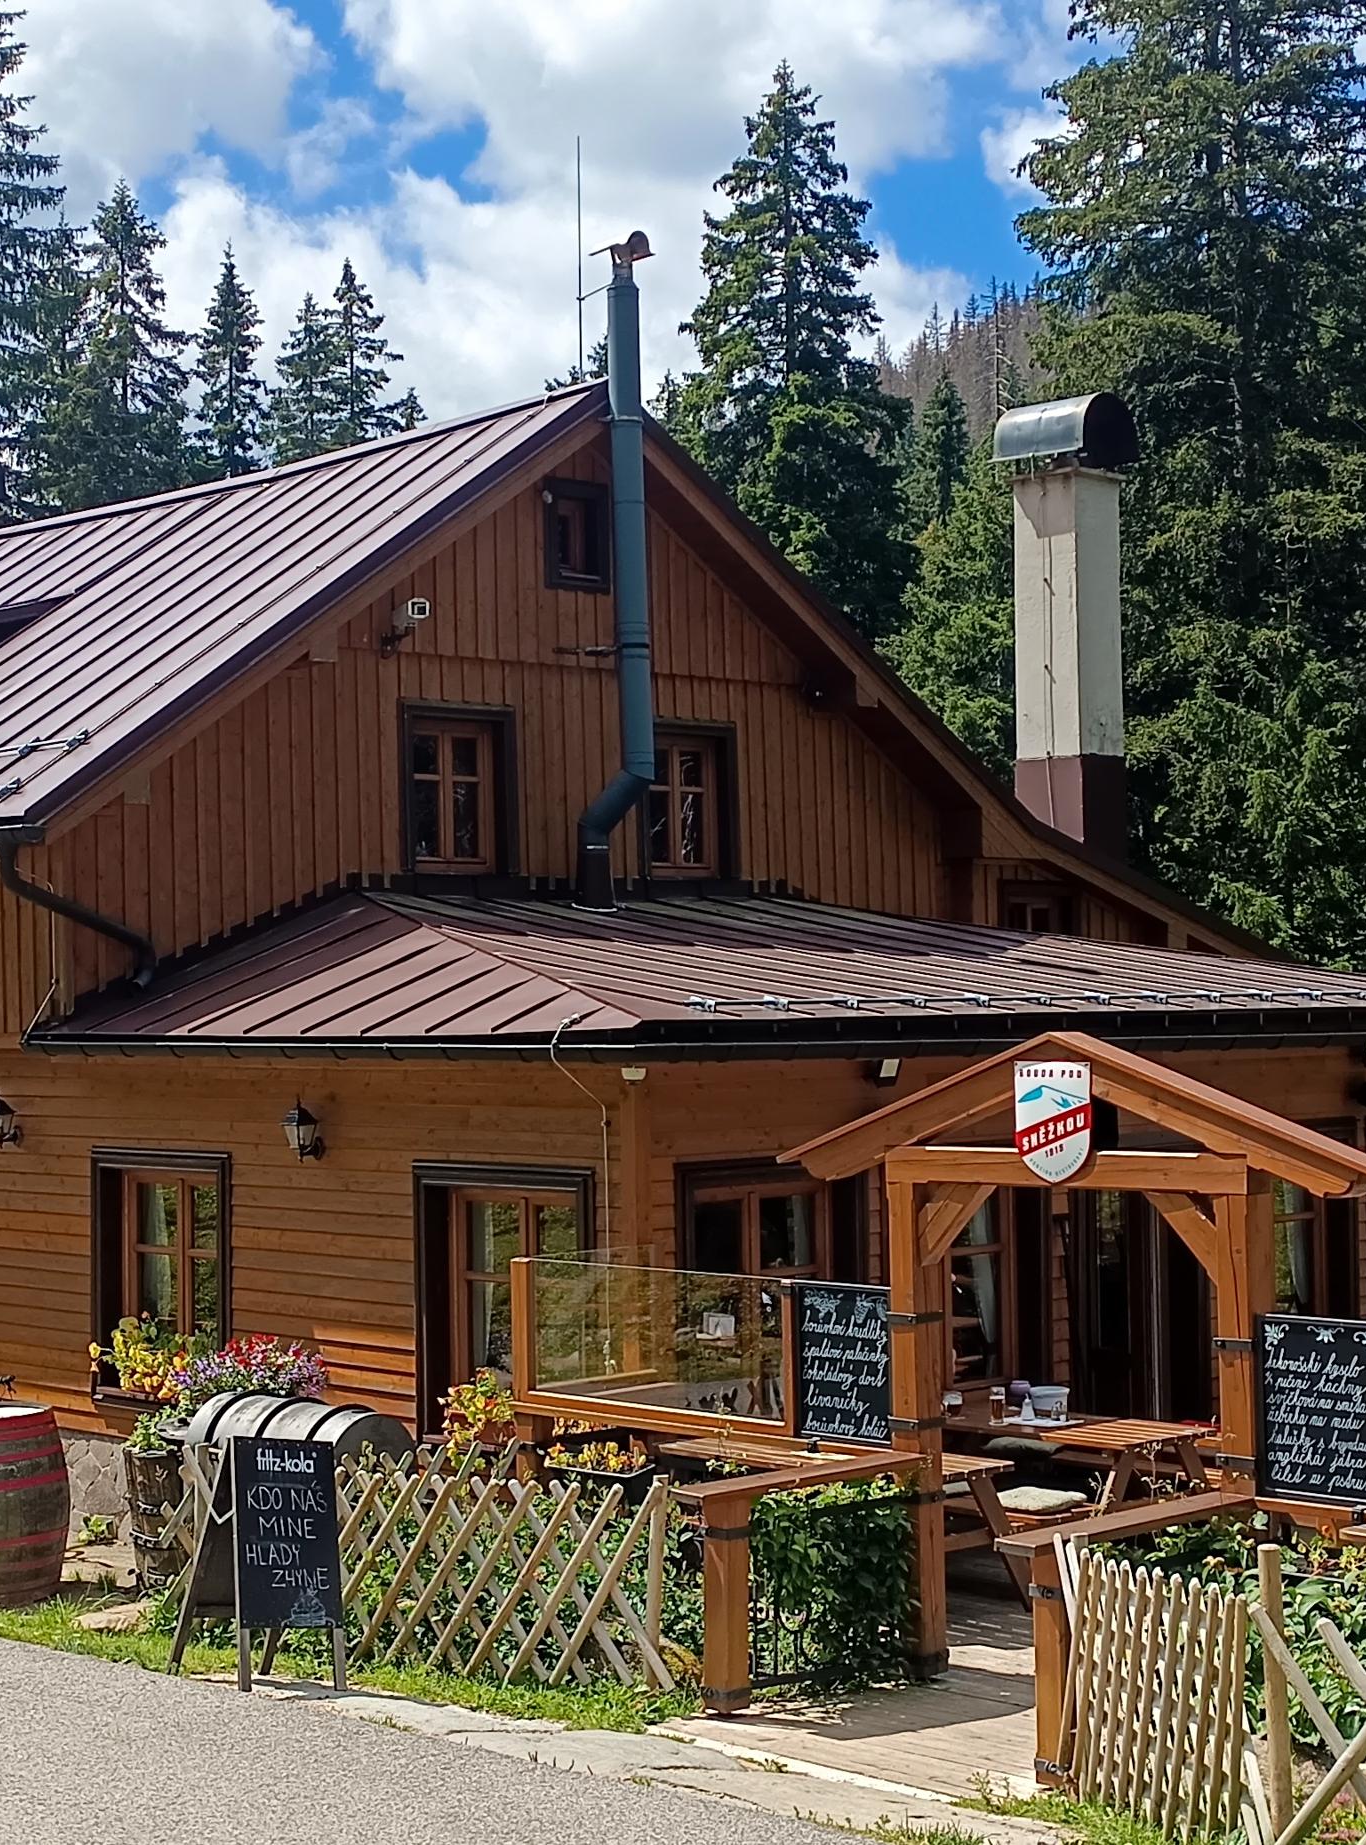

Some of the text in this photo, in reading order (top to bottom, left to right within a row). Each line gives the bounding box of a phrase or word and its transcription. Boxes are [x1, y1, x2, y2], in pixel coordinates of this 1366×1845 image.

[1061, 1069, 1082, 1079] POD
[1022, 1112, 1085, 1152] SNĚŽKOU
[858, 1364, 887, 1388] dort
[1322, 1352, 1366, 1380] kyselo
[1266, 1388, 1319, 1408] svíčková
[1317, 1399, 1335, 1410] na
[857, 1413, 888, 1438] koláč
[1308, 1415, 1328, 1427] na
[1330, 1412, 1366, 1430] medu
[1317, 1437, 1326, 1450] s
[256, 1447, 315, 1473] fritz-kola
[1267, 1446, 1326, 1467] anglická
[247, 1485, 283, 1510] KDO
[258, 1516, 318, 1540] MINE
[245, 1543, 301, 1566] HLADY
